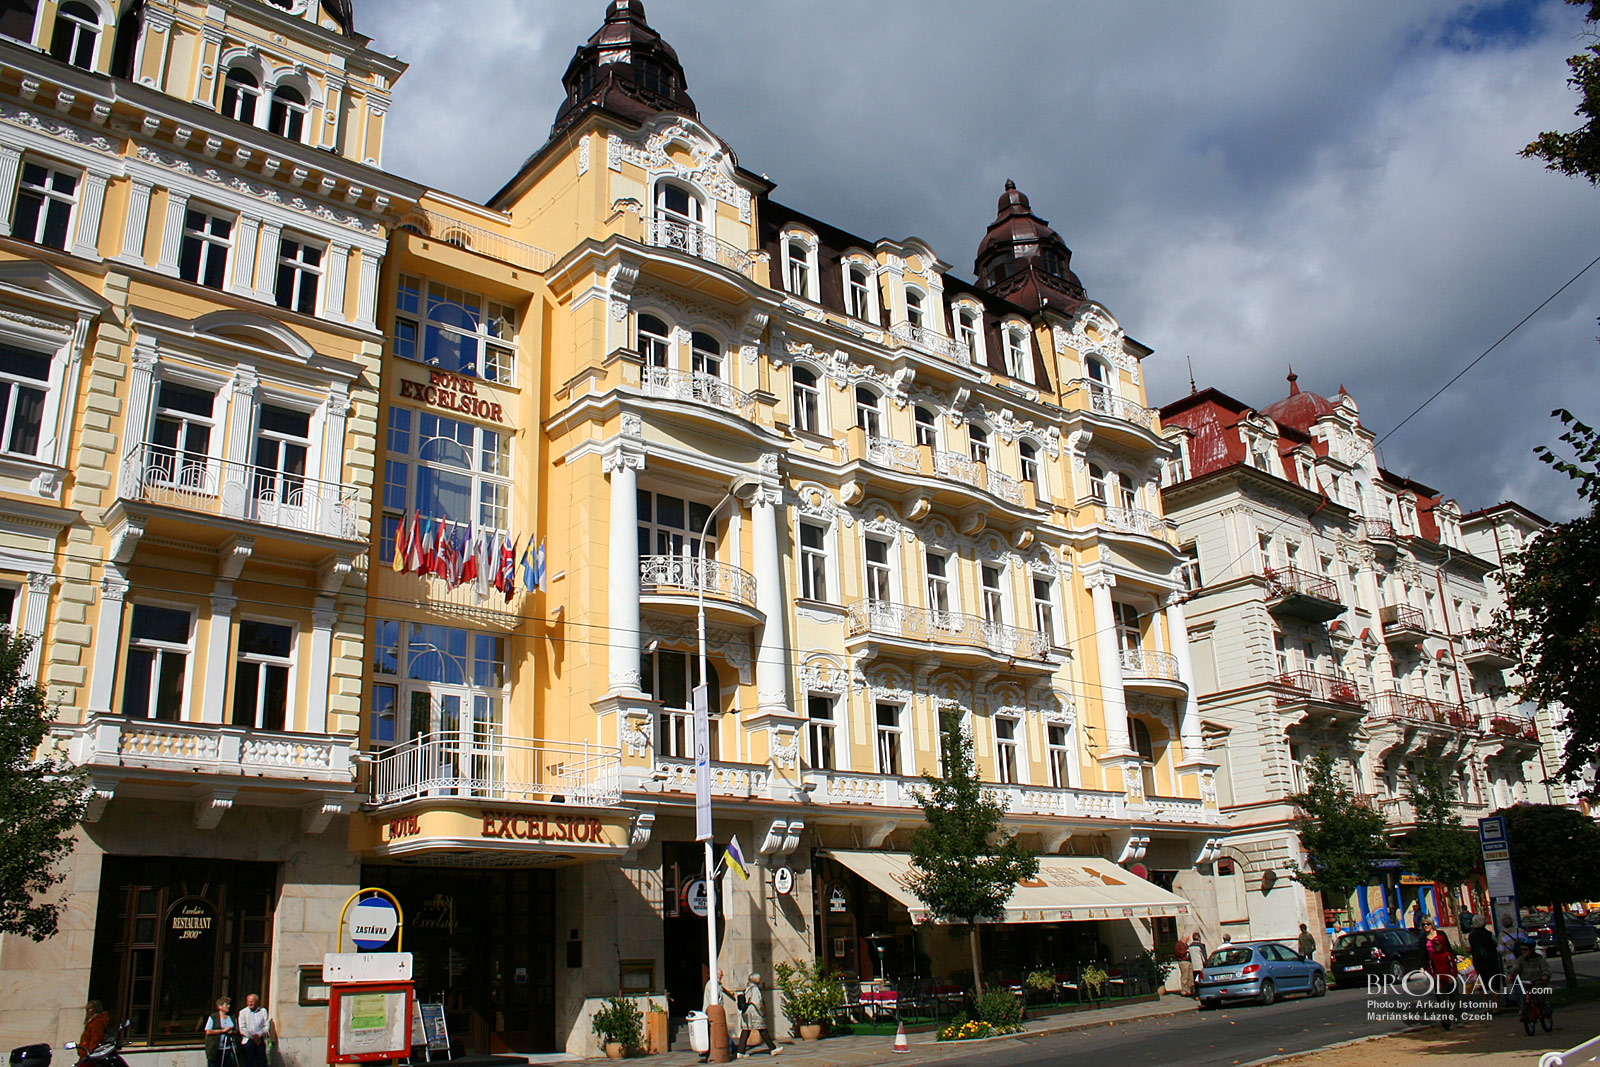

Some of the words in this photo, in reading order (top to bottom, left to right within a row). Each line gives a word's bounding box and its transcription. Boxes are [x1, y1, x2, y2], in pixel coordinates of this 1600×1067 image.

[430, 370, 478, 396] HOTEL
[400, 379, 503, 422] EXCELSIOR
[388, 814, 421, 839] HOTEL
[481, 811, 604, 843] EXCELSIOR
[172, 917, 212, 929] RESTAURANT
[355, 925, 388, 935] ZASTÁVKA
